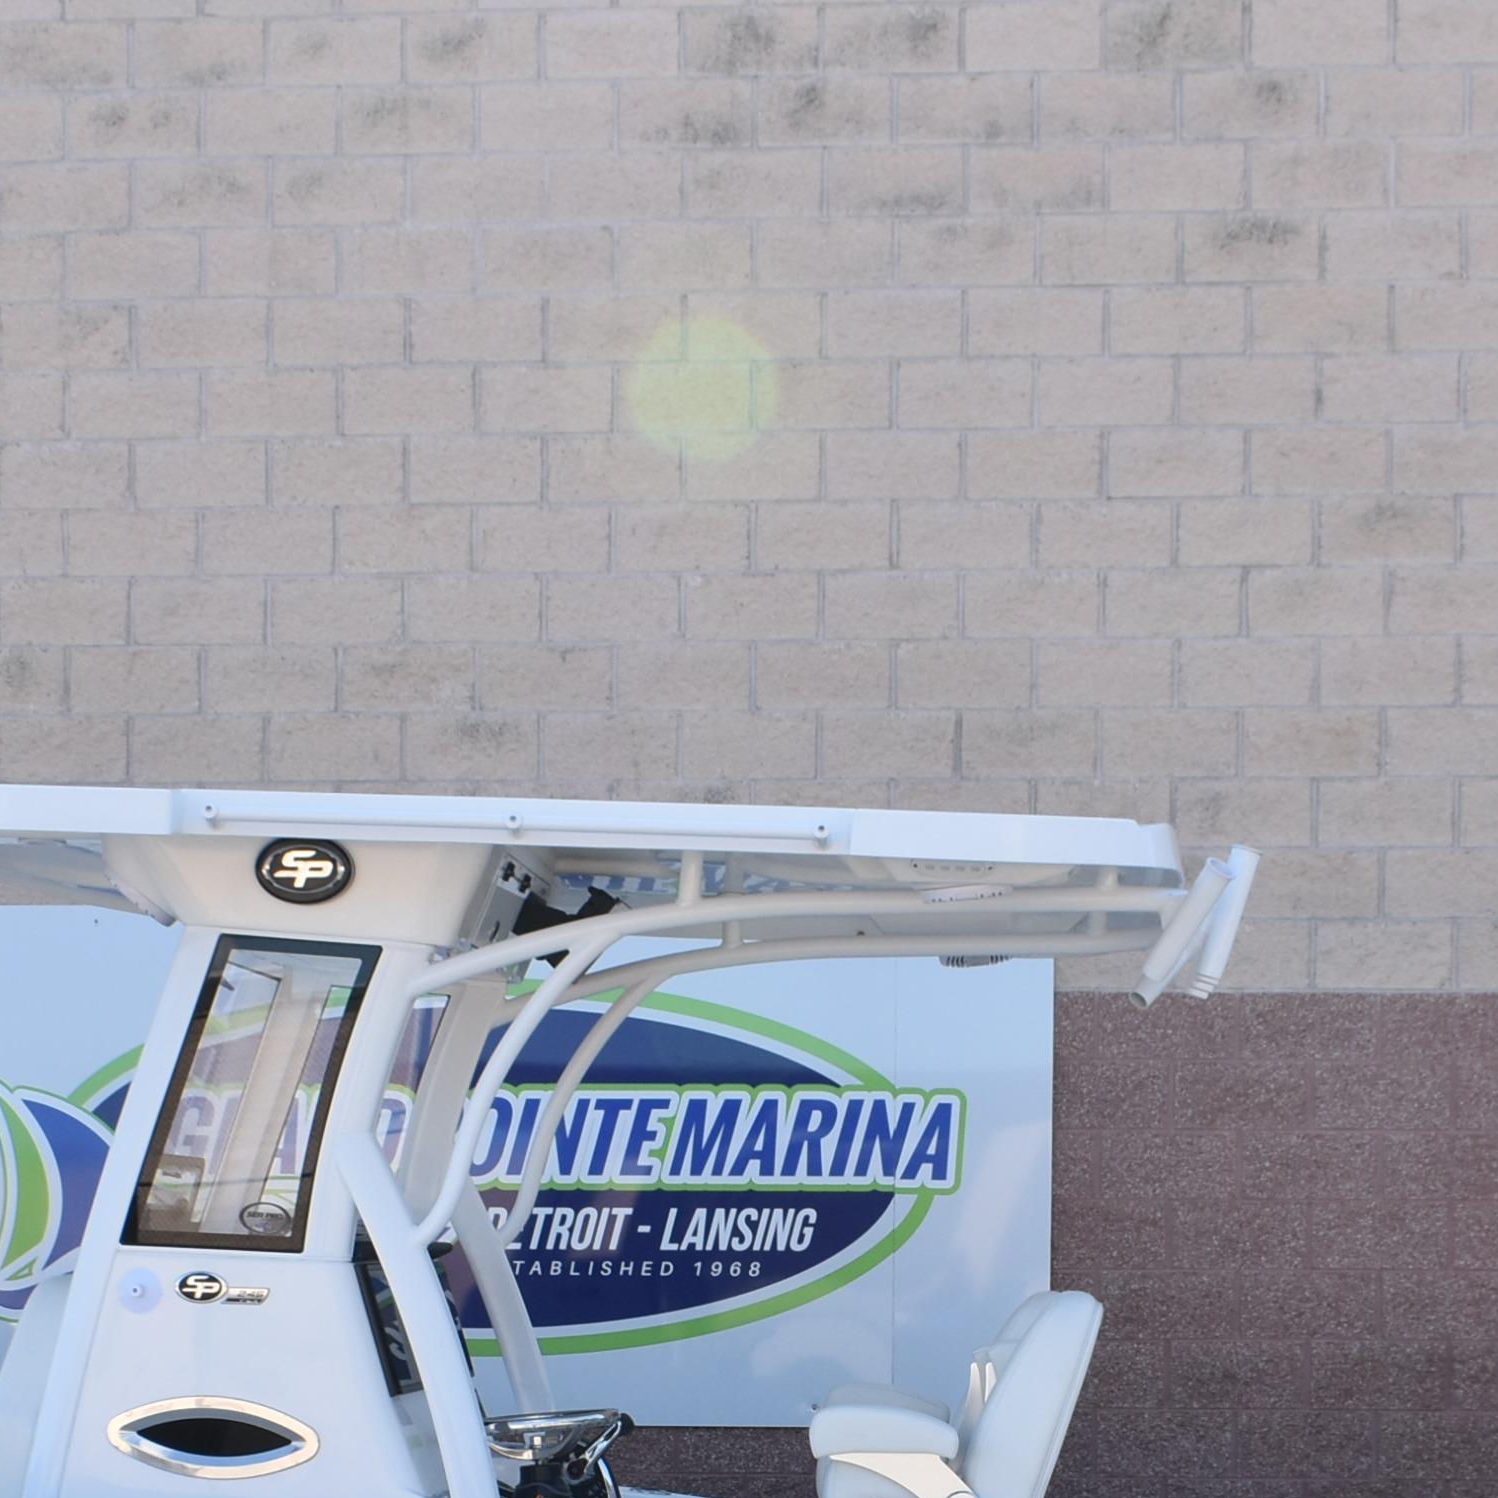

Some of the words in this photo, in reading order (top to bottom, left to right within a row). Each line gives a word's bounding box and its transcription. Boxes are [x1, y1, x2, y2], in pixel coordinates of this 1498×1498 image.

[463, 1096, 673, 1177] OINTE
[668, 1098, 954, 1181] MARINA
[487, 1207, 633, 1251] DTROIT
[659, 1207, 818, 1252] LANSING
[513, 1261, 675, 1277] TABLISHED
[693, 1261, 761, 1277] 1968
